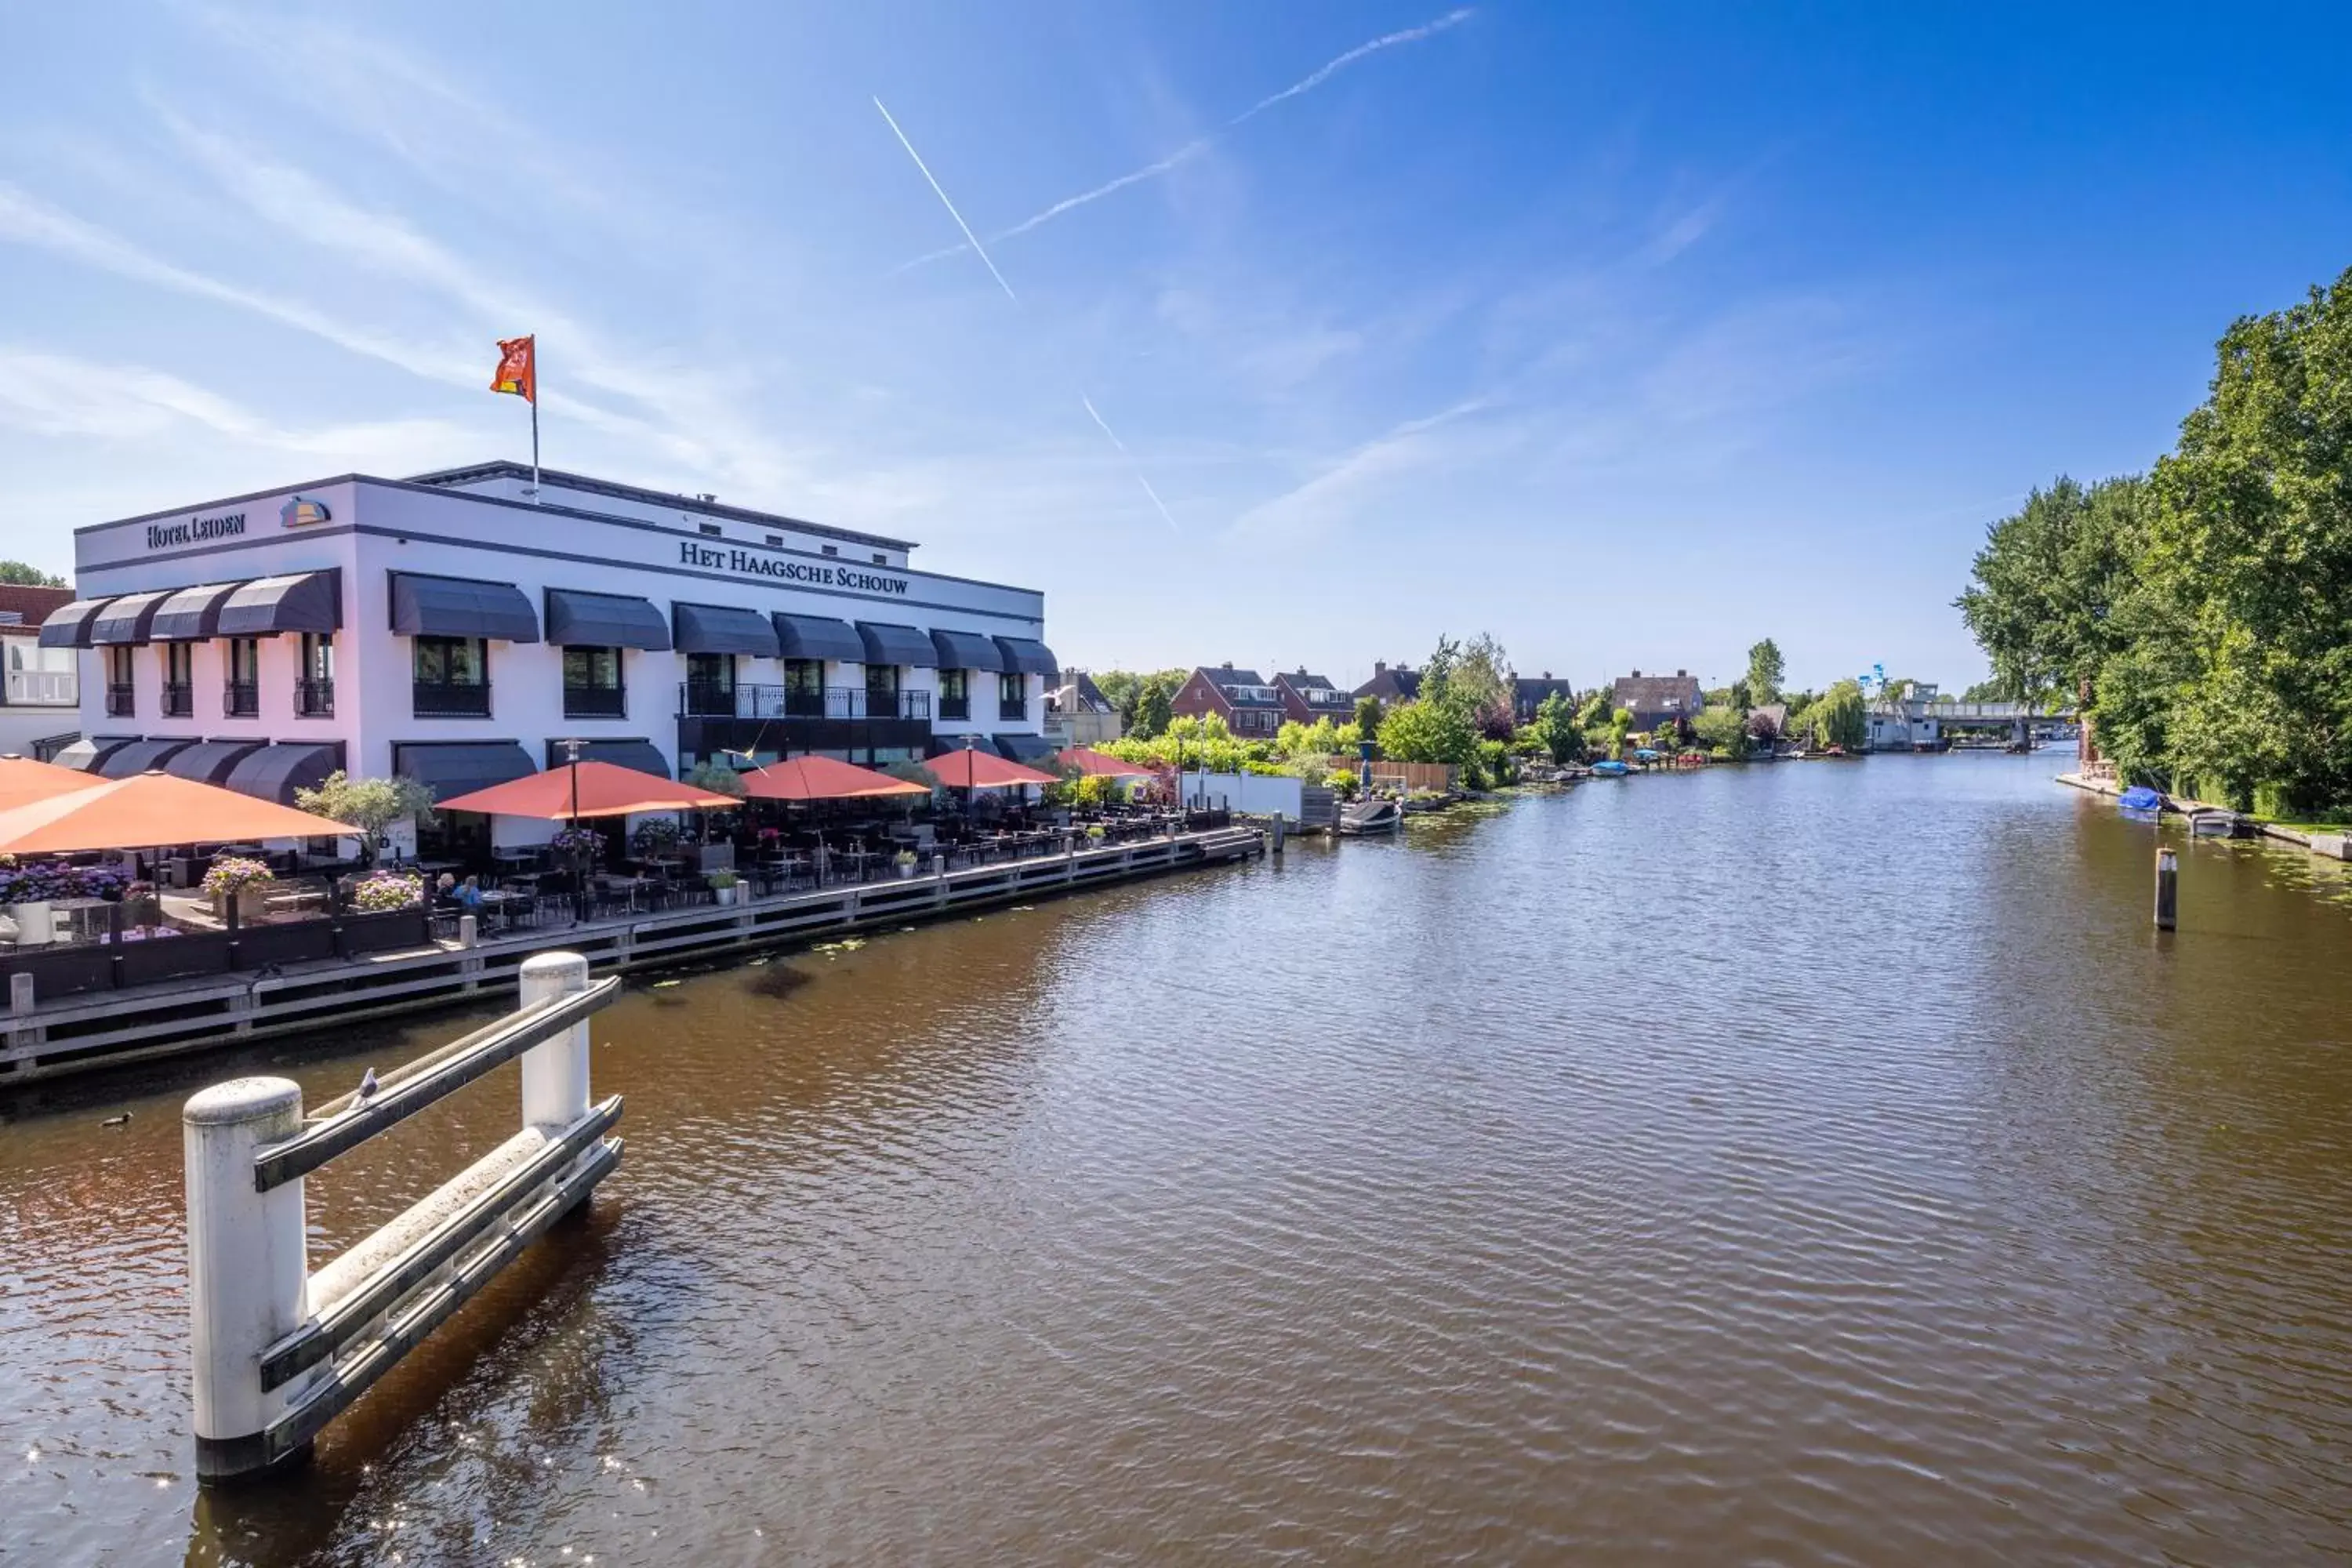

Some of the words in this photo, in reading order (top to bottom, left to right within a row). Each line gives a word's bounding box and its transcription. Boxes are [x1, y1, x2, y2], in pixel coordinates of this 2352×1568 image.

[147, 524, 191, 548] HOTEL
[192, 514, 245, 540] LEIDEN
[680, 542, 725, 568] HET
[730, 550, 833, 584] HAAGSCHE
[837, 568, 908, 594] SCHOUW
